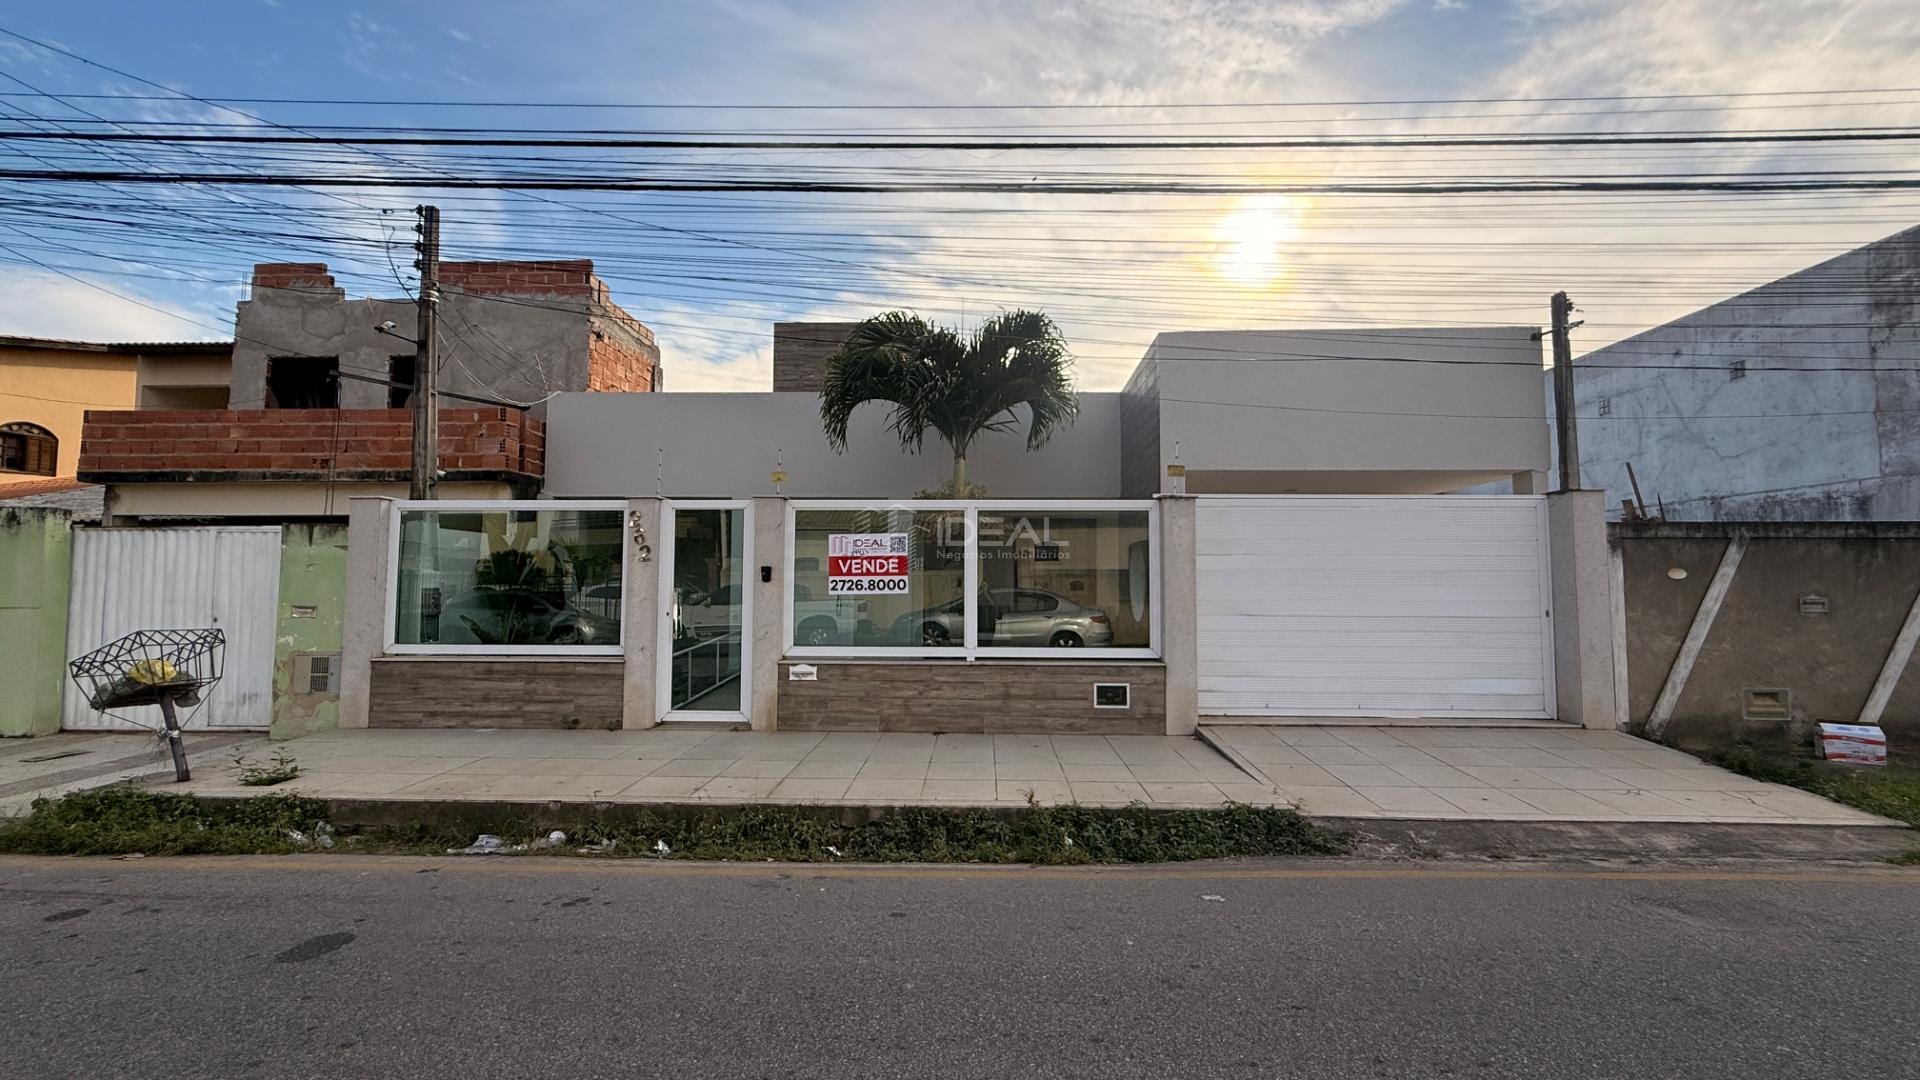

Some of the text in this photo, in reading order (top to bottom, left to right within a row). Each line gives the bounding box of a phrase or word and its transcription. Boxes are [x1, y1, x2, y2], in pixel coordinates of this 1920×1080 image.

[853, 539, 887, 547] IDEAL
[838, 559, 899, 573] VENDE
[830, 579, 907, 591] 2726.8000
